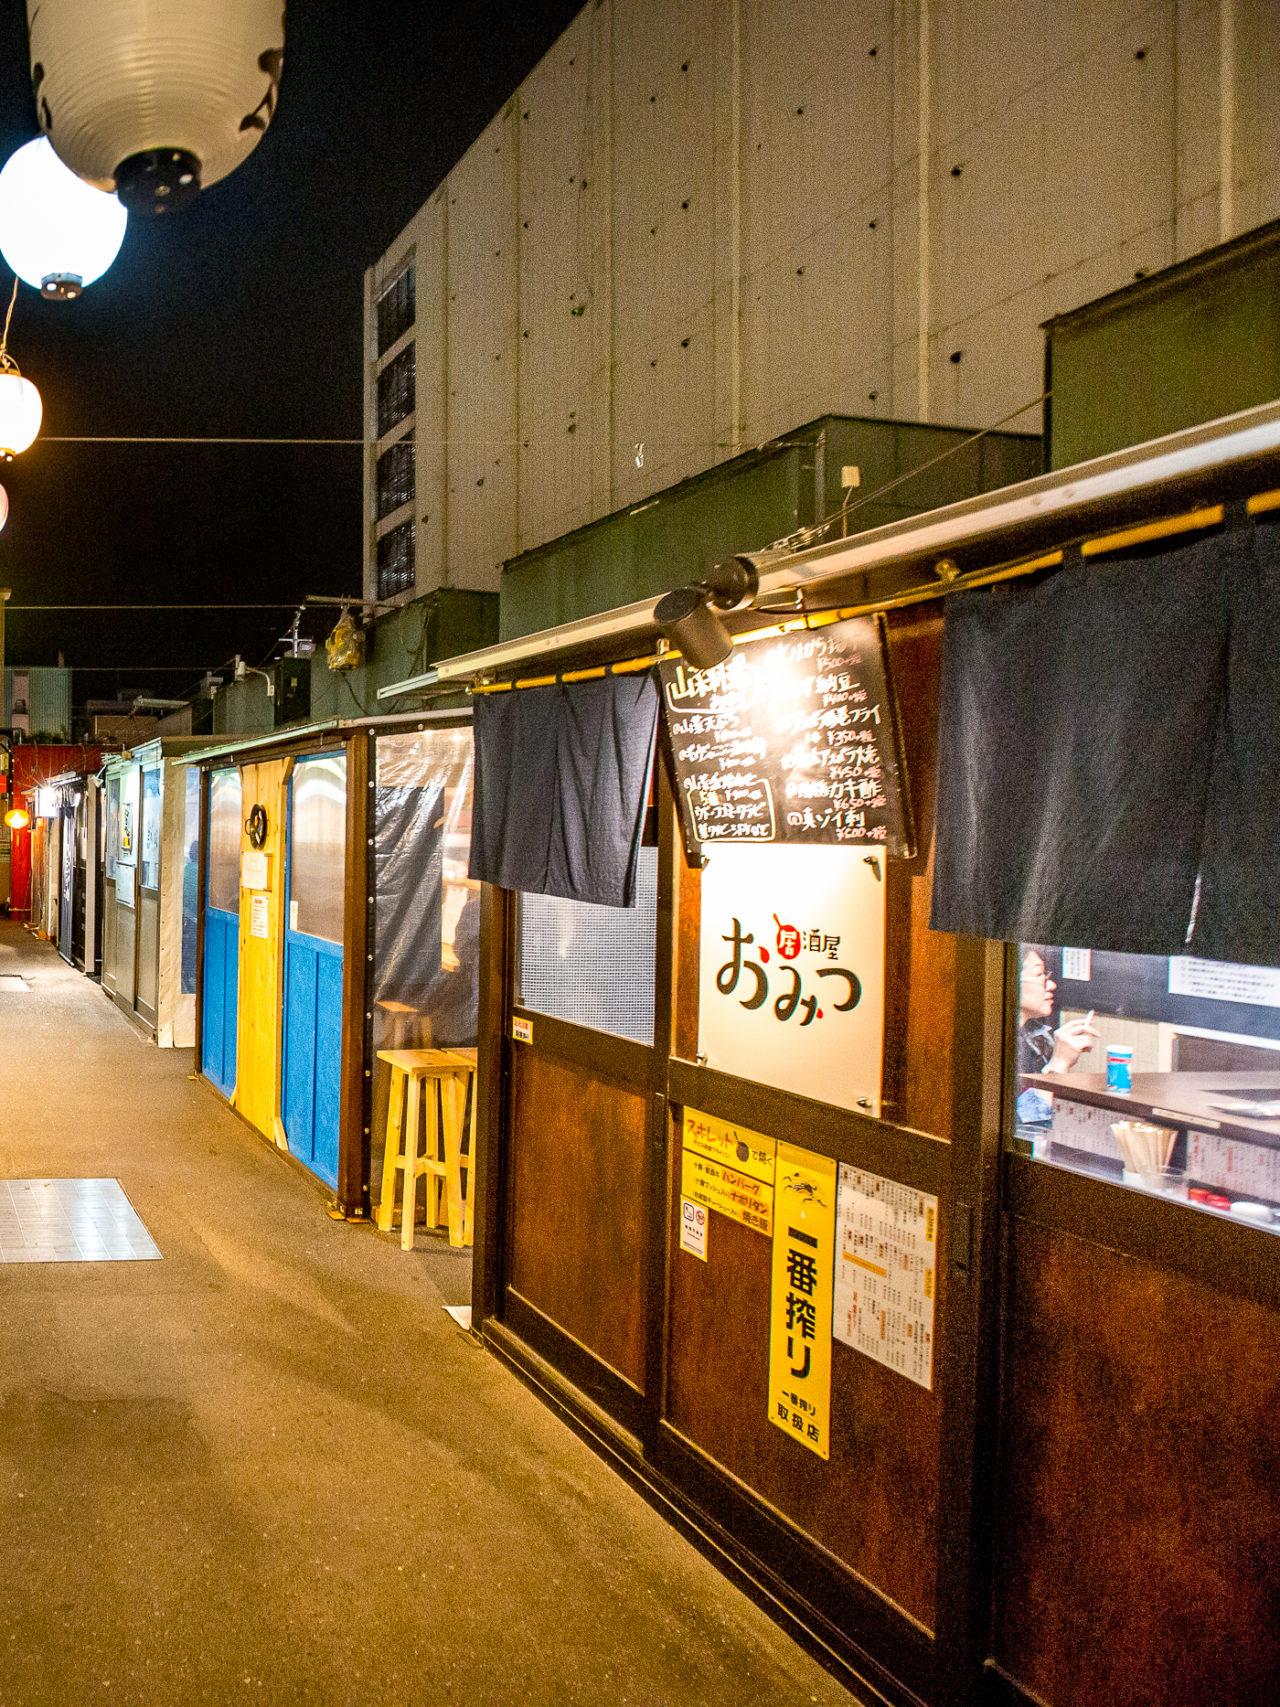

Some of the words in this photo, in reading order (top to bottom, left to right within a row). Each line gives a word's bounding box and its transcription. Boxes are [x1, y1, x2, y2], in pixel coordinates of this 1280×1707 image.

[777, 929, 841, 960] 居酒屋
[716, 917, 862, 1026] おみつ
[722, 1170, 761, 1196] ハンバーグ
[730, 1190, 768, 1215] ナポリタン
[786, 1226, 818, 1379] 一番搾り
[782, 1390, 816, 1417] 一番搾り
[777, 1402, 820, 1443] 取扱店
